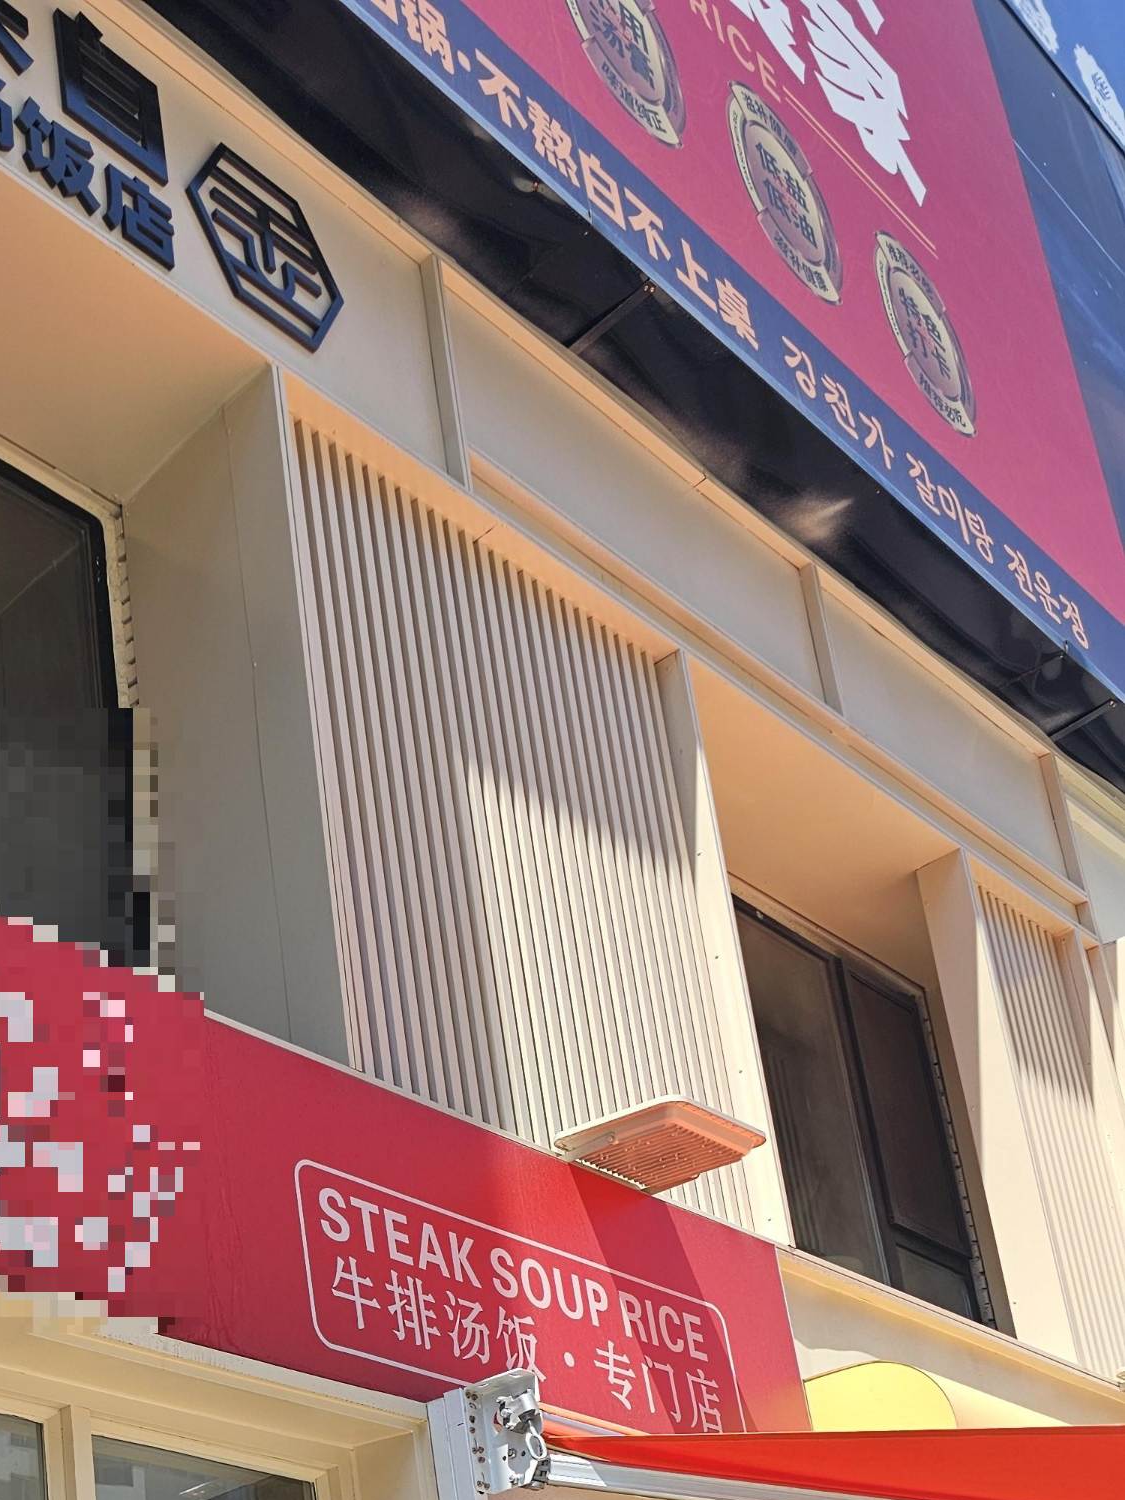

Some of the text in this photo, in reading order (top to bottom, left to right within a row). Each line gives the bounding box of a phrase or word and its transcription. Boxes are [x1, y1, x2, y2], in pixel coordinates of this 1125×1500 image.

[370, 0, 759, 351] 锅·不熬白不上桌
[318, 1187, 709, 1363] STEAK SOUP RICE
